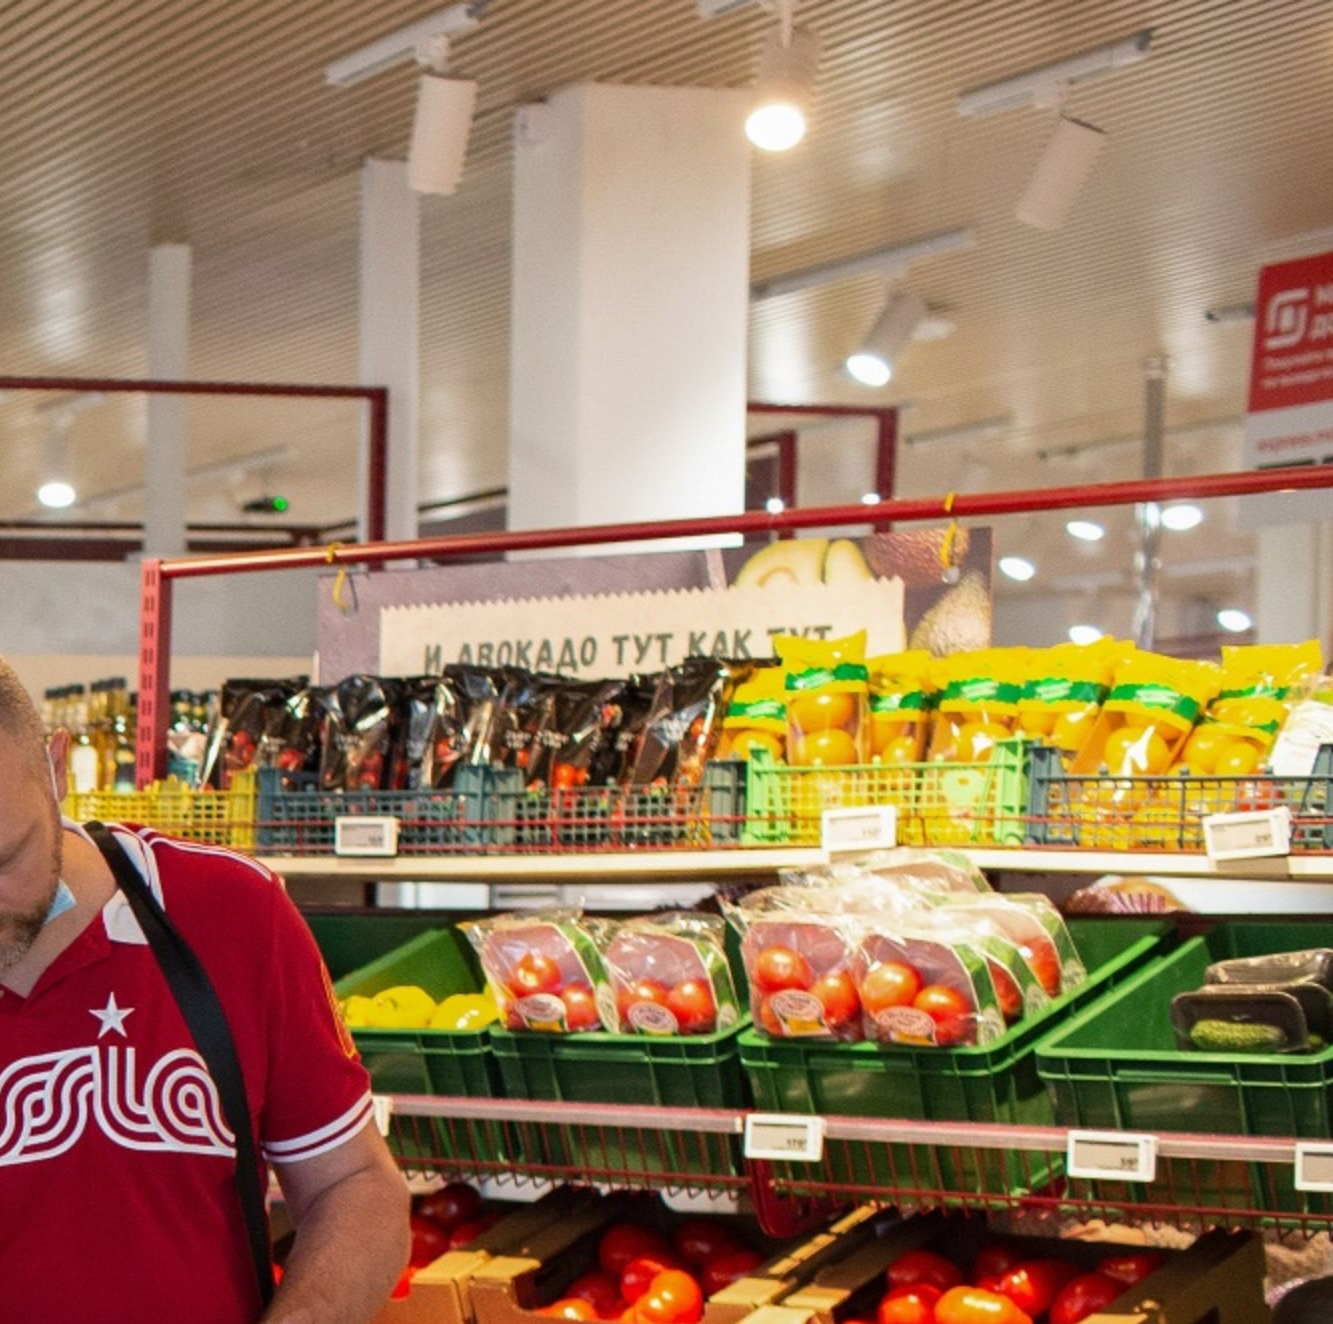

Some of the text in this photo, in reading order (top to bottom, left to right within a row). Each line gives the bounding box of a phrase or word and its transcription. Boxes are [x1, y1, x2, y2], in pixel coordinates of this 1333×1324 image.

[458, 635, 598, 673] АВОКАДО
[612, 632, 673, 664] ТУТ
[687, 629, 752, 660] КАК
